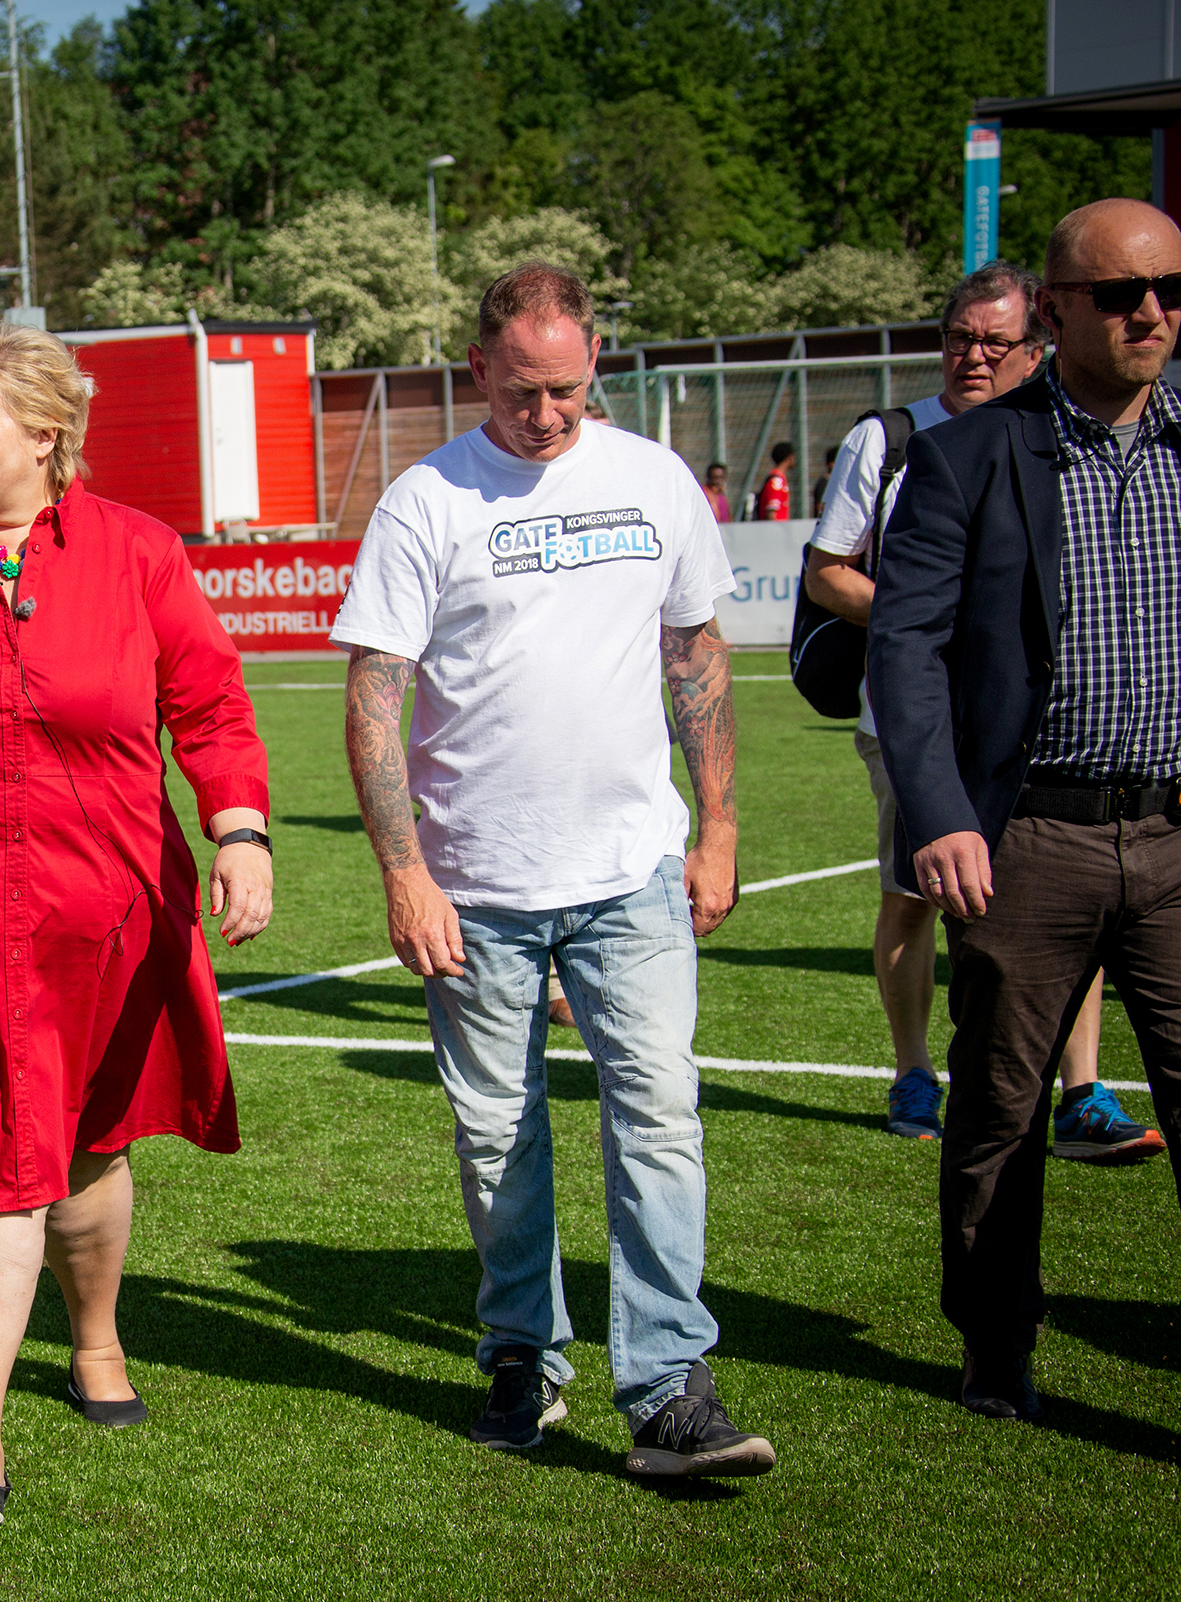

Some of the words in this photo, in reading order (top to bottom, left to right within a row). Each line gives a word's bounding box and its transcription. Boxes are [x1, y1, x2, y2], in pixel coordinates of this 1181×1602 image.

[566, 510, 641, 530] KONGSVINGER
[495, 523, 557, 553] GATE
[494, 562, 512, 575] NM
[515, 557, 539, 571] 2018
